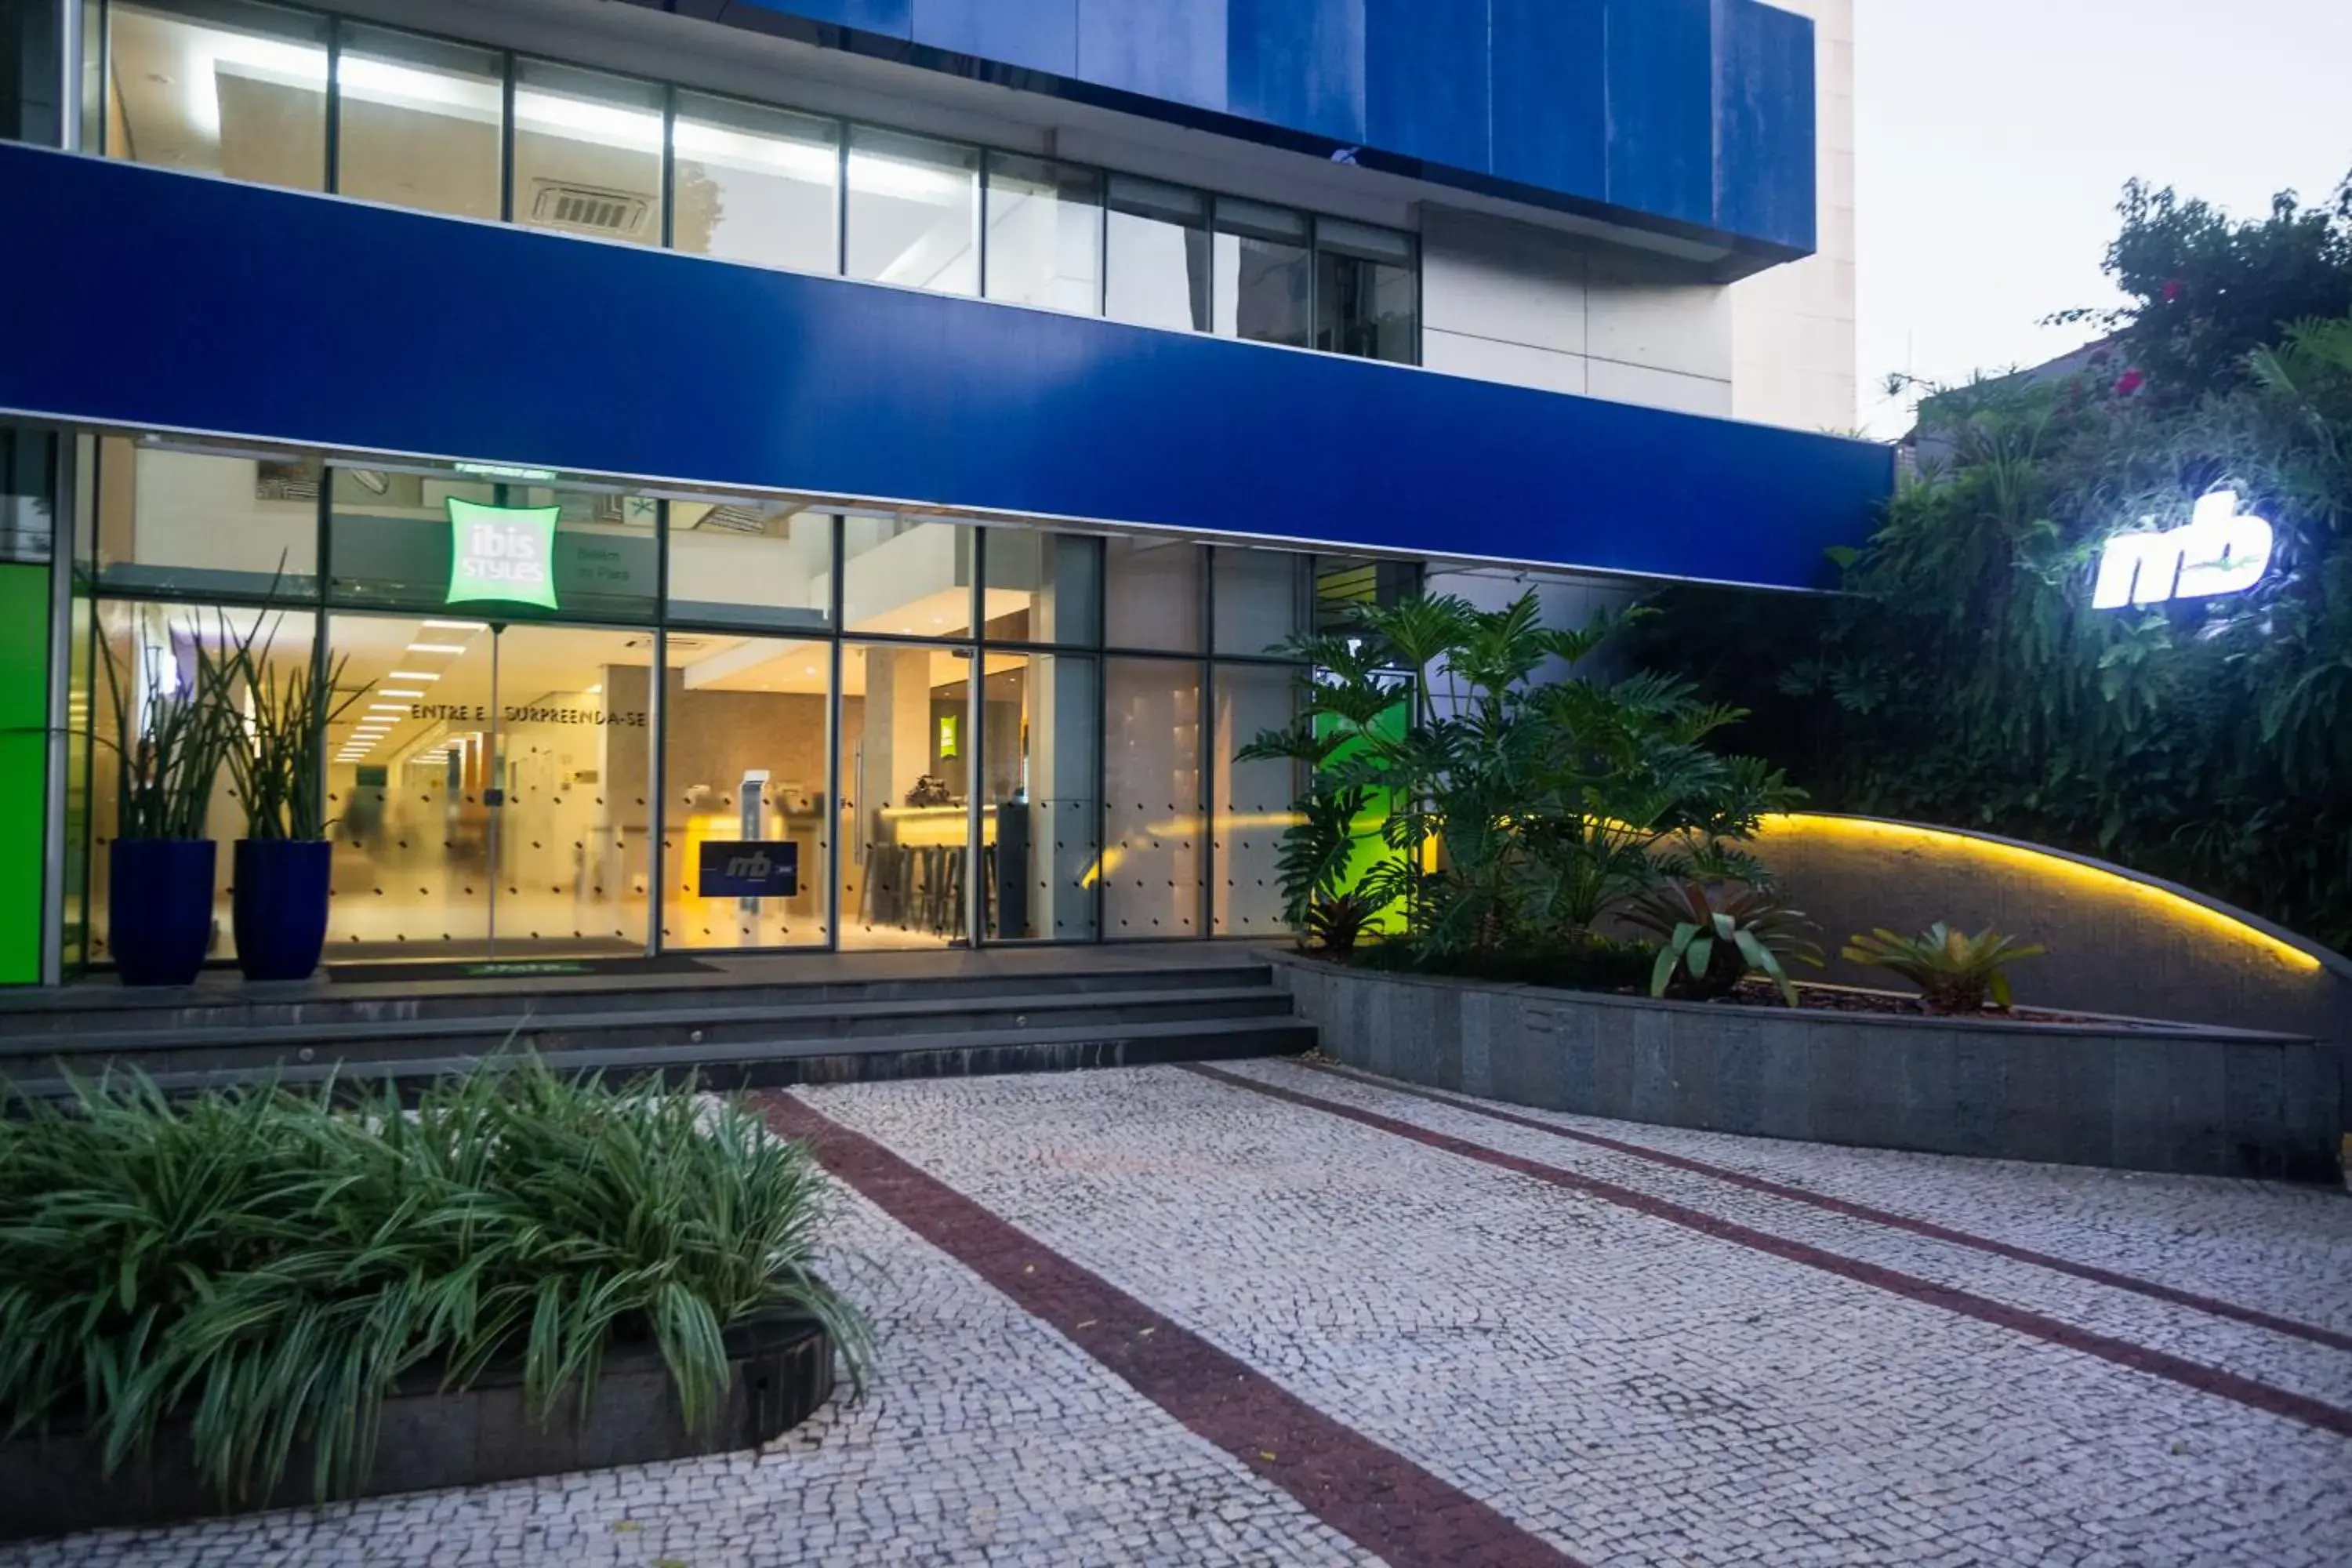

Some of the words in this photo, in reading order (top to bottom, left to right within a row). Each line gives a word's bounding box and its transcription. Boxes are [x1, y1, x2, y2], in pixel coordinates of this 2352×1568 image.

[471, 523, 535, 559] ibis
[411, 703, 468, 721] ENTRE
[475, 706, 485, 722] E
[504, 706, 647, 728] SURPREENDA-SE
